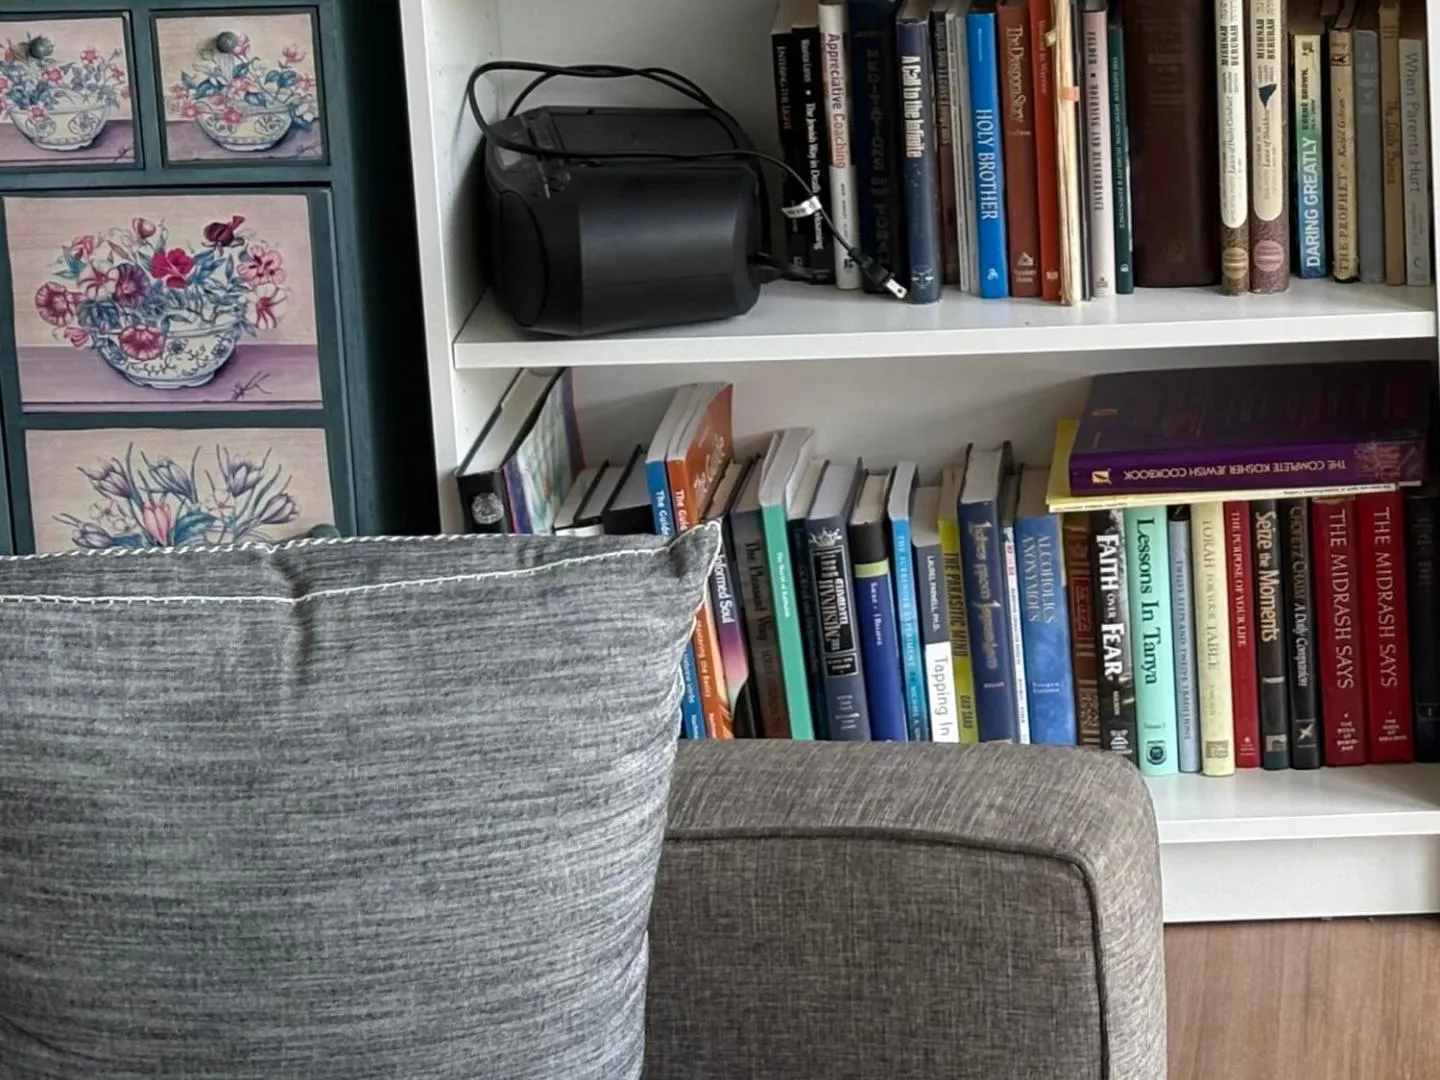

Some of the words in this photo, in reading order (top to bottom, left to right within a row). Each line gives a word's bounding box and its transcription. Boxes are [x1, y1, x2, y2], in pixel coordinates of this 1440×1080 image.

[827, 33, 843, 111] Appreciative
[830, 112, 847, 169] Coaching
[976, 108, 995, 149] HOLY
[977, 153, 998, 220] BROTHER
[1303, 137, 1319, 206] GREATLY
[1305, 207, 1321, 268] DARING
[1123, 468, 1187, 481] COOKBOOK
[1189, 466, 1226, 476] JEWISH
[1228, 464, 1270, 475] KOSHER
[1272, 461, 1323, 473] COMPLETE
[1256, 512, 1277, 549] Seize
[1374, 507, 1392, 545] THE
[1023, 536, 1038, 623] ANONYMOUS
[1037, 535, 1058, 624] ALCOHOLICS
[1096, 533, 1120, 591] FAITH
[1136, 519, 1157, 595] Lessons
[1141, 601, 1159, 621] In
[1260, 571, 1281, 642] Moments
[1375, 552, 1397, 640] MIDRASH
[1102, 622, 1123, 677] FEAR
[1142, 625, 1166, 685] Tanya
[1380, 644, 1398, 687] SAYS
